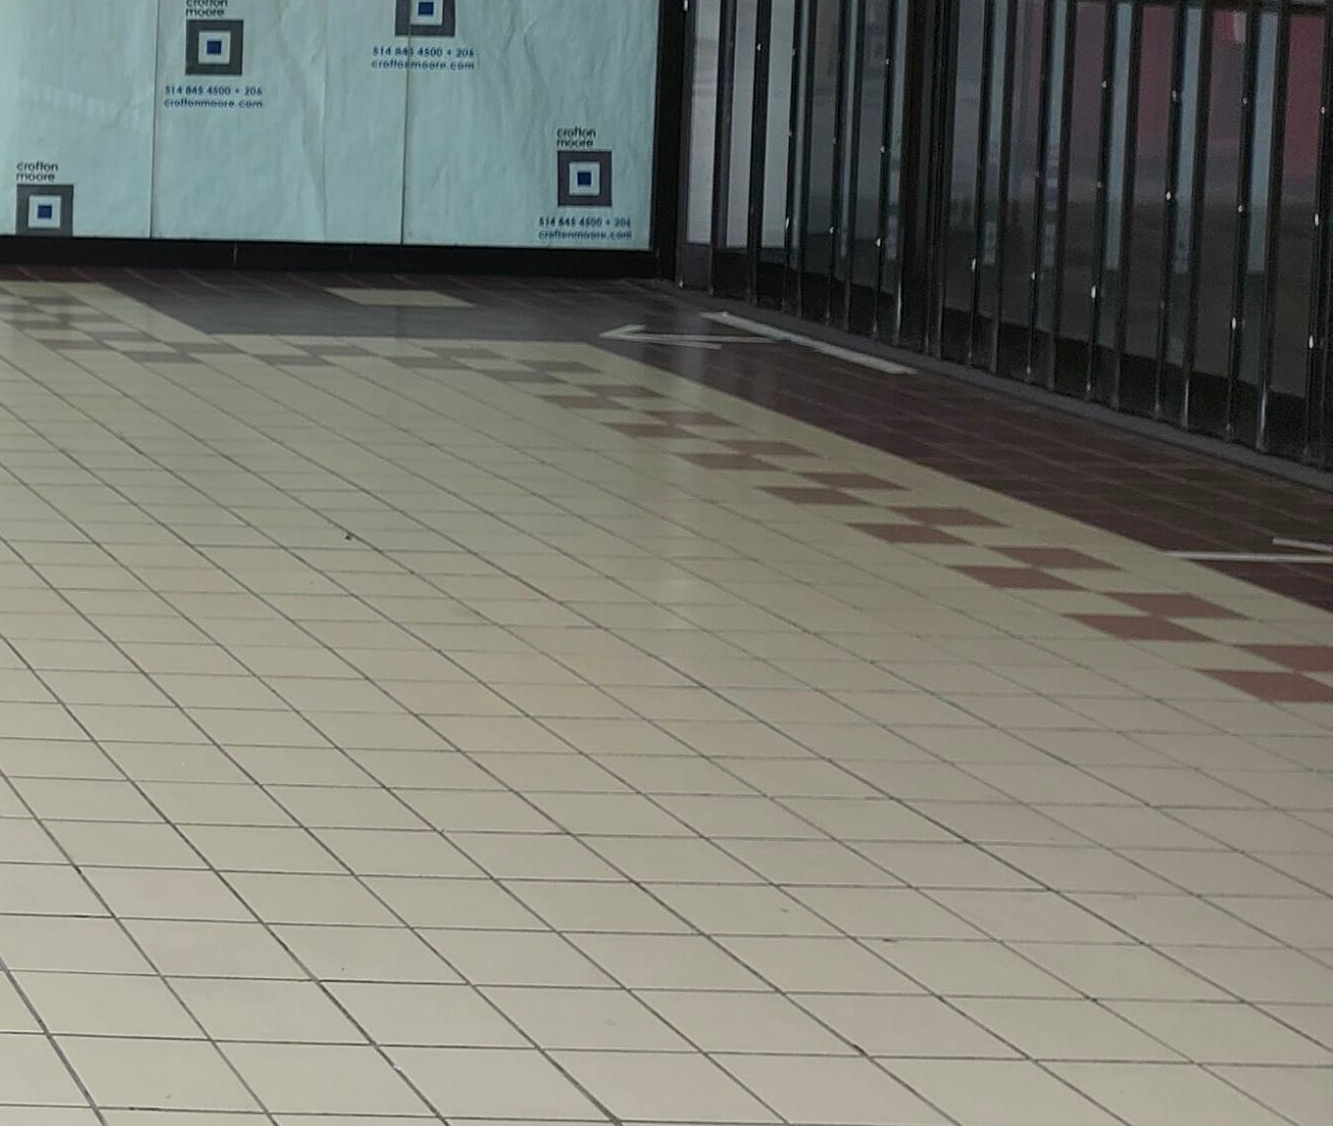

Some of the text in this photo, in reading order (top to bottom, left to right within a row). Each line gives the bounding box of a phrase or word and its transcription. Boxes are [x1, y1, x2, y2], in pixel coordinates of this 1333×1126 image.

[186, 8, 224, 17] moore
[165, 86, 182, 95] 514
[207, 86, 231, 96] 4500
[557, 126, 596, 137] crofton
[557, 139, 593, 147] moore
[16, 160, 58, 171] crofton
[16, 173, 55, 181] moore
